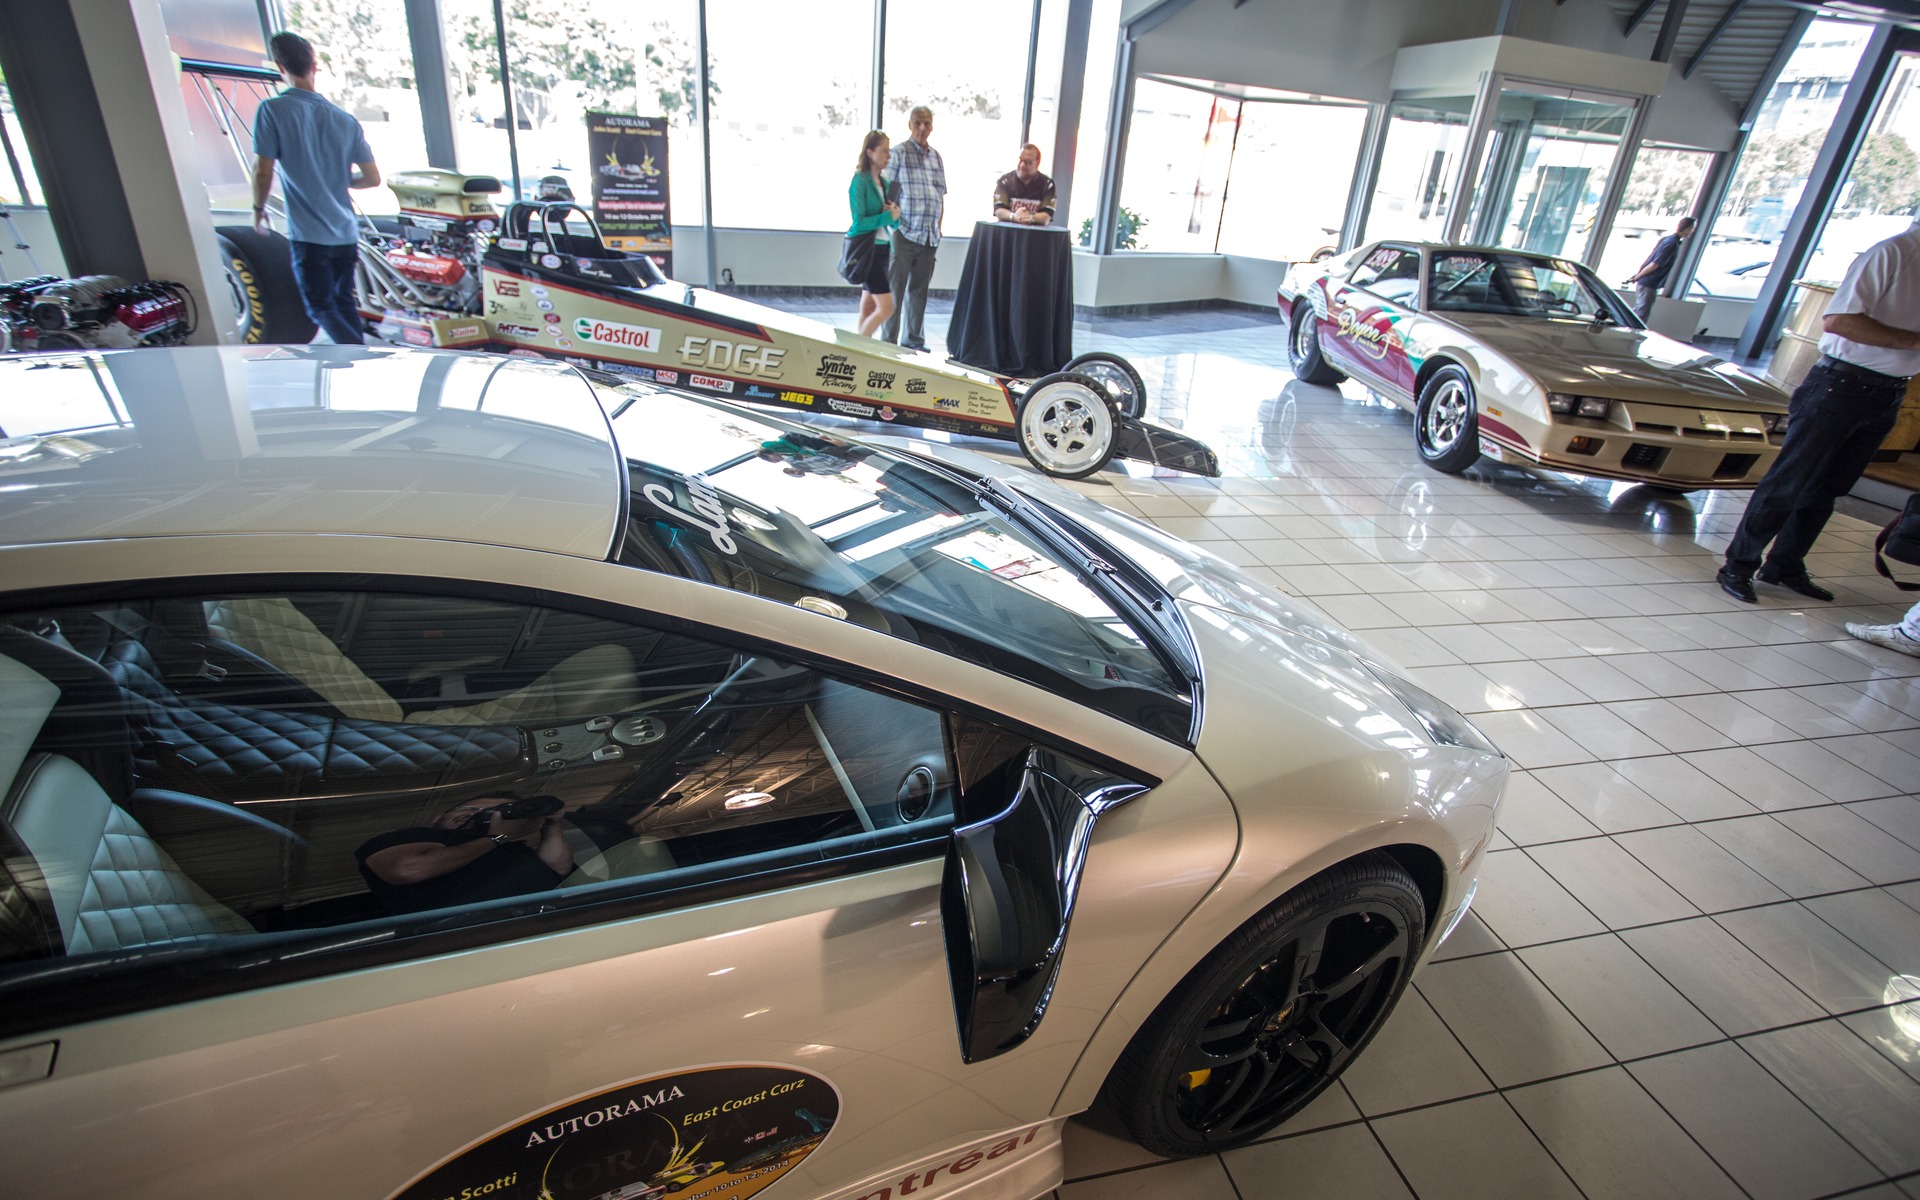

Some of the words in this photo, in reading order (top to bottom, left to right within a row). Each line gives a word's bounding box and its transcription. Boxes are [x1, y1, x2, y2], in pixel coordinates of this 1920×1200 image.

[605, 116, 651, 128] AUTORAMA
[594, 322, 650, 348] Castrol
[1336, 307, 1383, 345] Doyon
[676, 333, 789, 380] EDGE
[817, 355, 857, 376] Syntec
[829, 353, 847, 362] Castrol
[692, 376, 723, 388] COMP
[822, 376, 857, 394] Racing
[867, 378, 894, 389] GTX
[868, 370, 896, 380] Castrol
[683, 1106, 718, 1127] East
[721, 1089, 767, 1113] Coast
[770, 1077, 806, 1097] Carz
[525, 1084, 686, 1148] AUTORAMA
[461, 1172, 518, 1200] Scotti
[713, 1183, 728, 1193] 10
[728, 1178, 743, 1187] to
[761, 1159, 790, 1176] 2014
